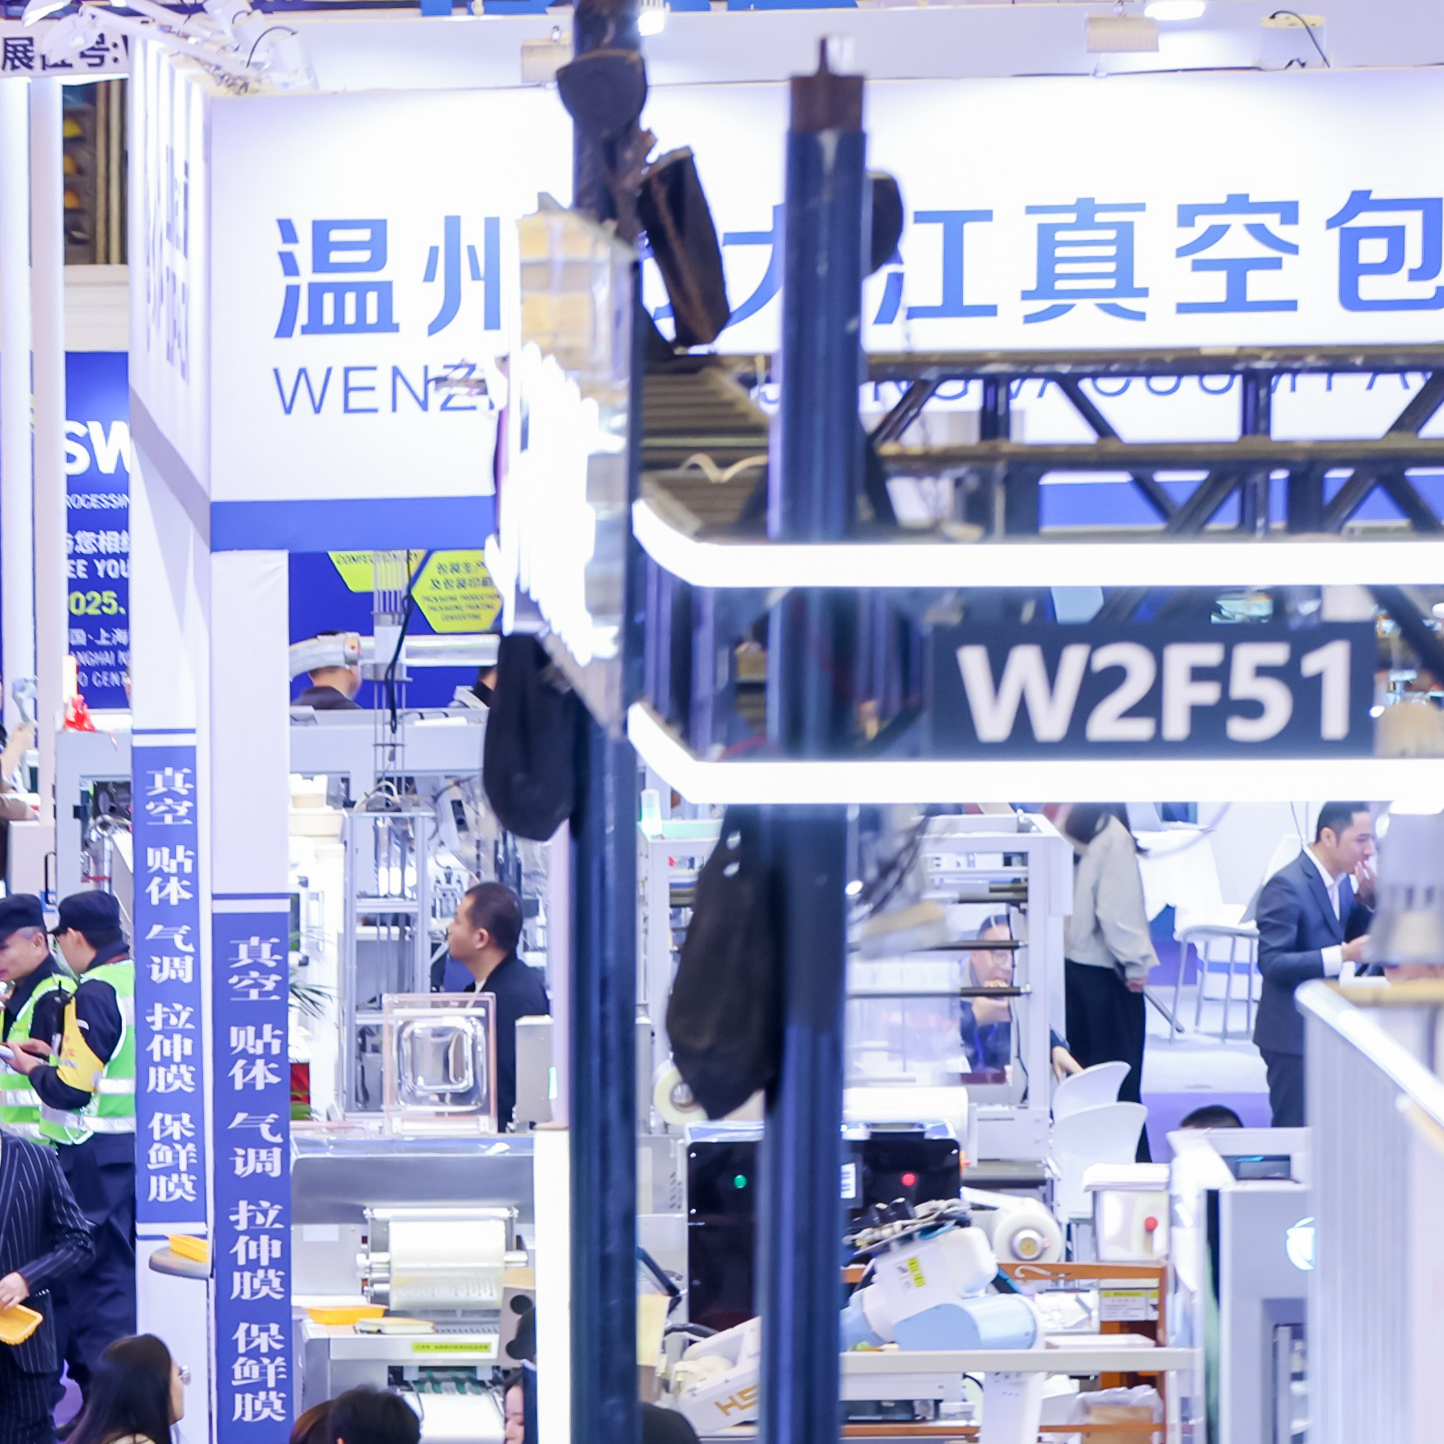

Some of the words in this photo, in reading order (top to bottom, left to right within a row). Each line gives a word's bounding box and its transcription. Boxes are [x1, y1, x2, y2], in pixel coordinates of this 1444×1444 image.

[273, 362, 495, 415] WENZ
[69, 590, 126, 616] 025.
[956, 639, 1354, 743] W2F51
[145, 766, 194, 825] 真空
[146, 844, 196, 906] 贴体
[145, 923, 195, 985] 气调
[228, 935, 284, 1001] 真空
[145, 1002, 197, 1095] 拉伸膜
[228, 1023, 282, 1091] 贴体
[147, 1111, 198, 1204] 保鲜膜
[228, 1111, 284, 1179] 气调
[229, 1199, 285, 1301] 拉伸膜
[230, 1321, 288, 1423] 保鲜膜
